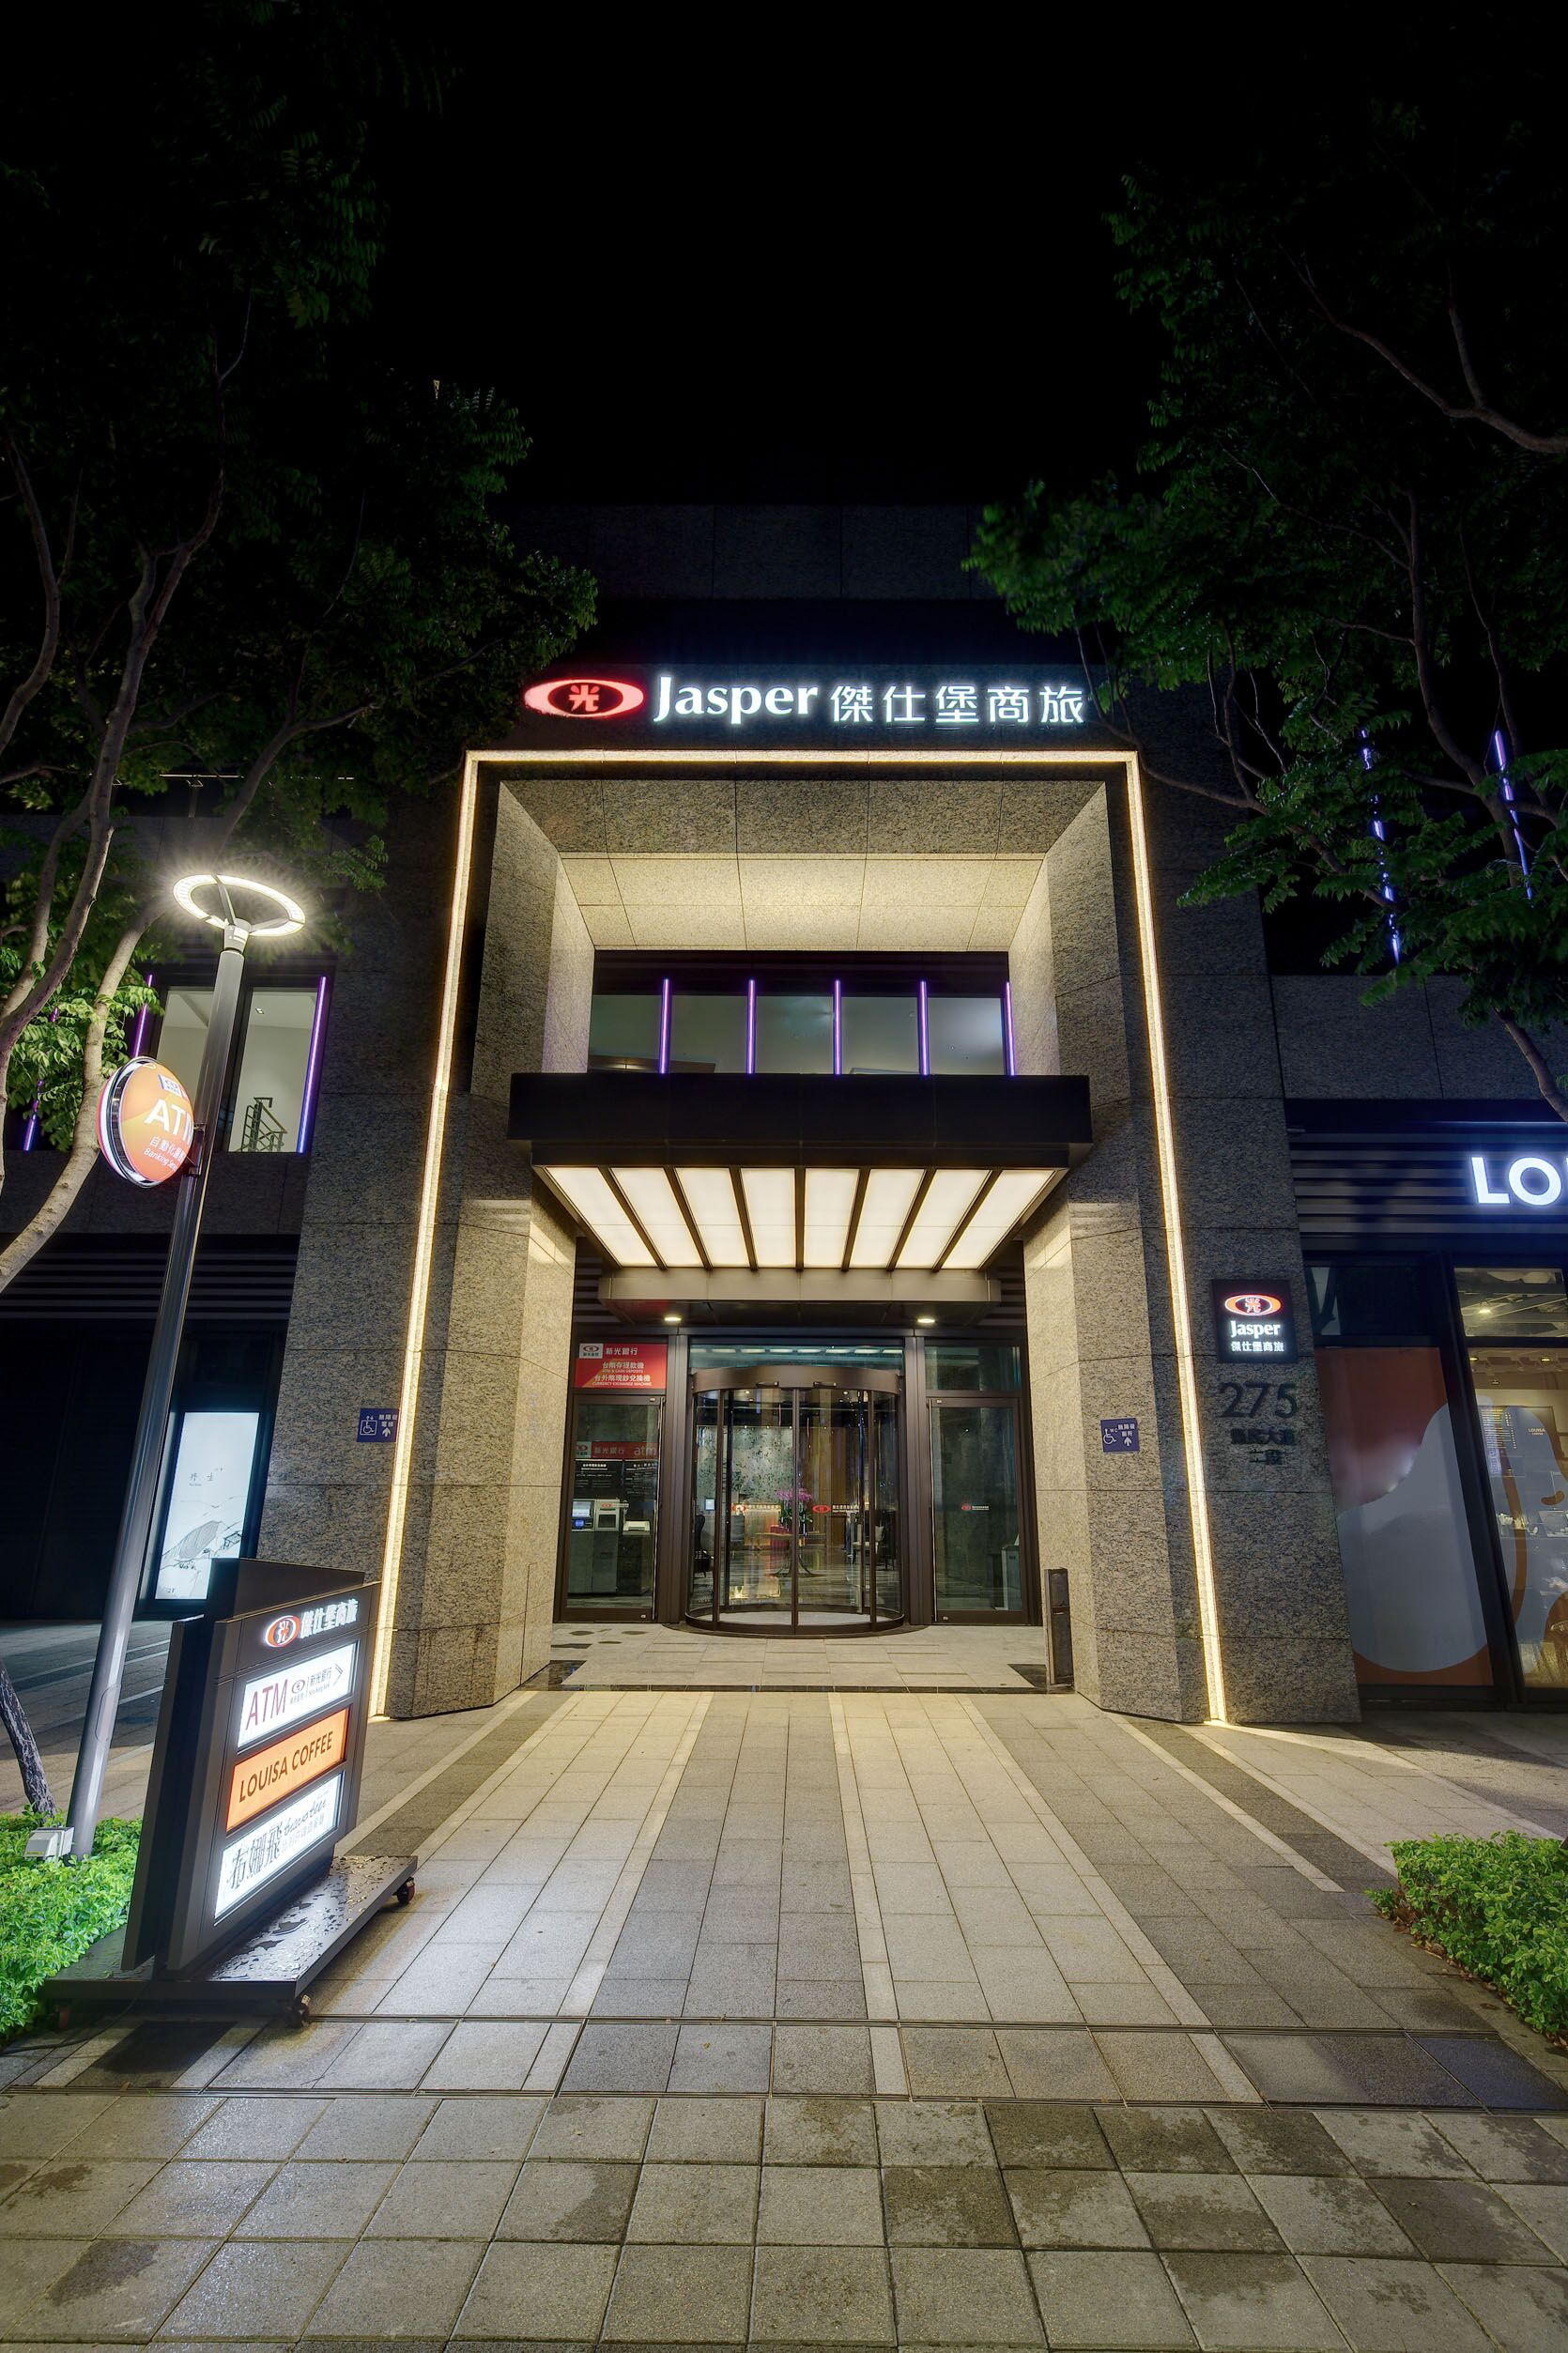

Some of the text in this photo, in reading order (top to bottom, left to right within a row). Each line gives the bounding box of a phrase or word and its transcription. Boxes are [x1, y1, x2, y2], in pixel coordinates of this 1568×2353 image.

[568, 675, 1086, 725] 光 Jasper 傑仕堡商旅
[144, 1147, 169, 1167] Banking
[1471, 1157, 1568, 1206] LO
[1230, 1320, 1281, 1339] Jasper
[1231, 1341, 1285, 1352] 傑仕堡商旅
[606, 1347, 638, 1356] 新光銀行
[1218, 1381, 1299, 1419] 275
[594, 1446, 625, 1455] 新光銀行
[634, 1445, 657, 1456] atm
[300, 1598, 359, 1639] 傑仕堡商旅
[245, 1678, 288, 1731] ATM
[238, 1730, 333, 1803] LOUISA COFFEE
[226, 1820, 284, 1891] 布娜飛
